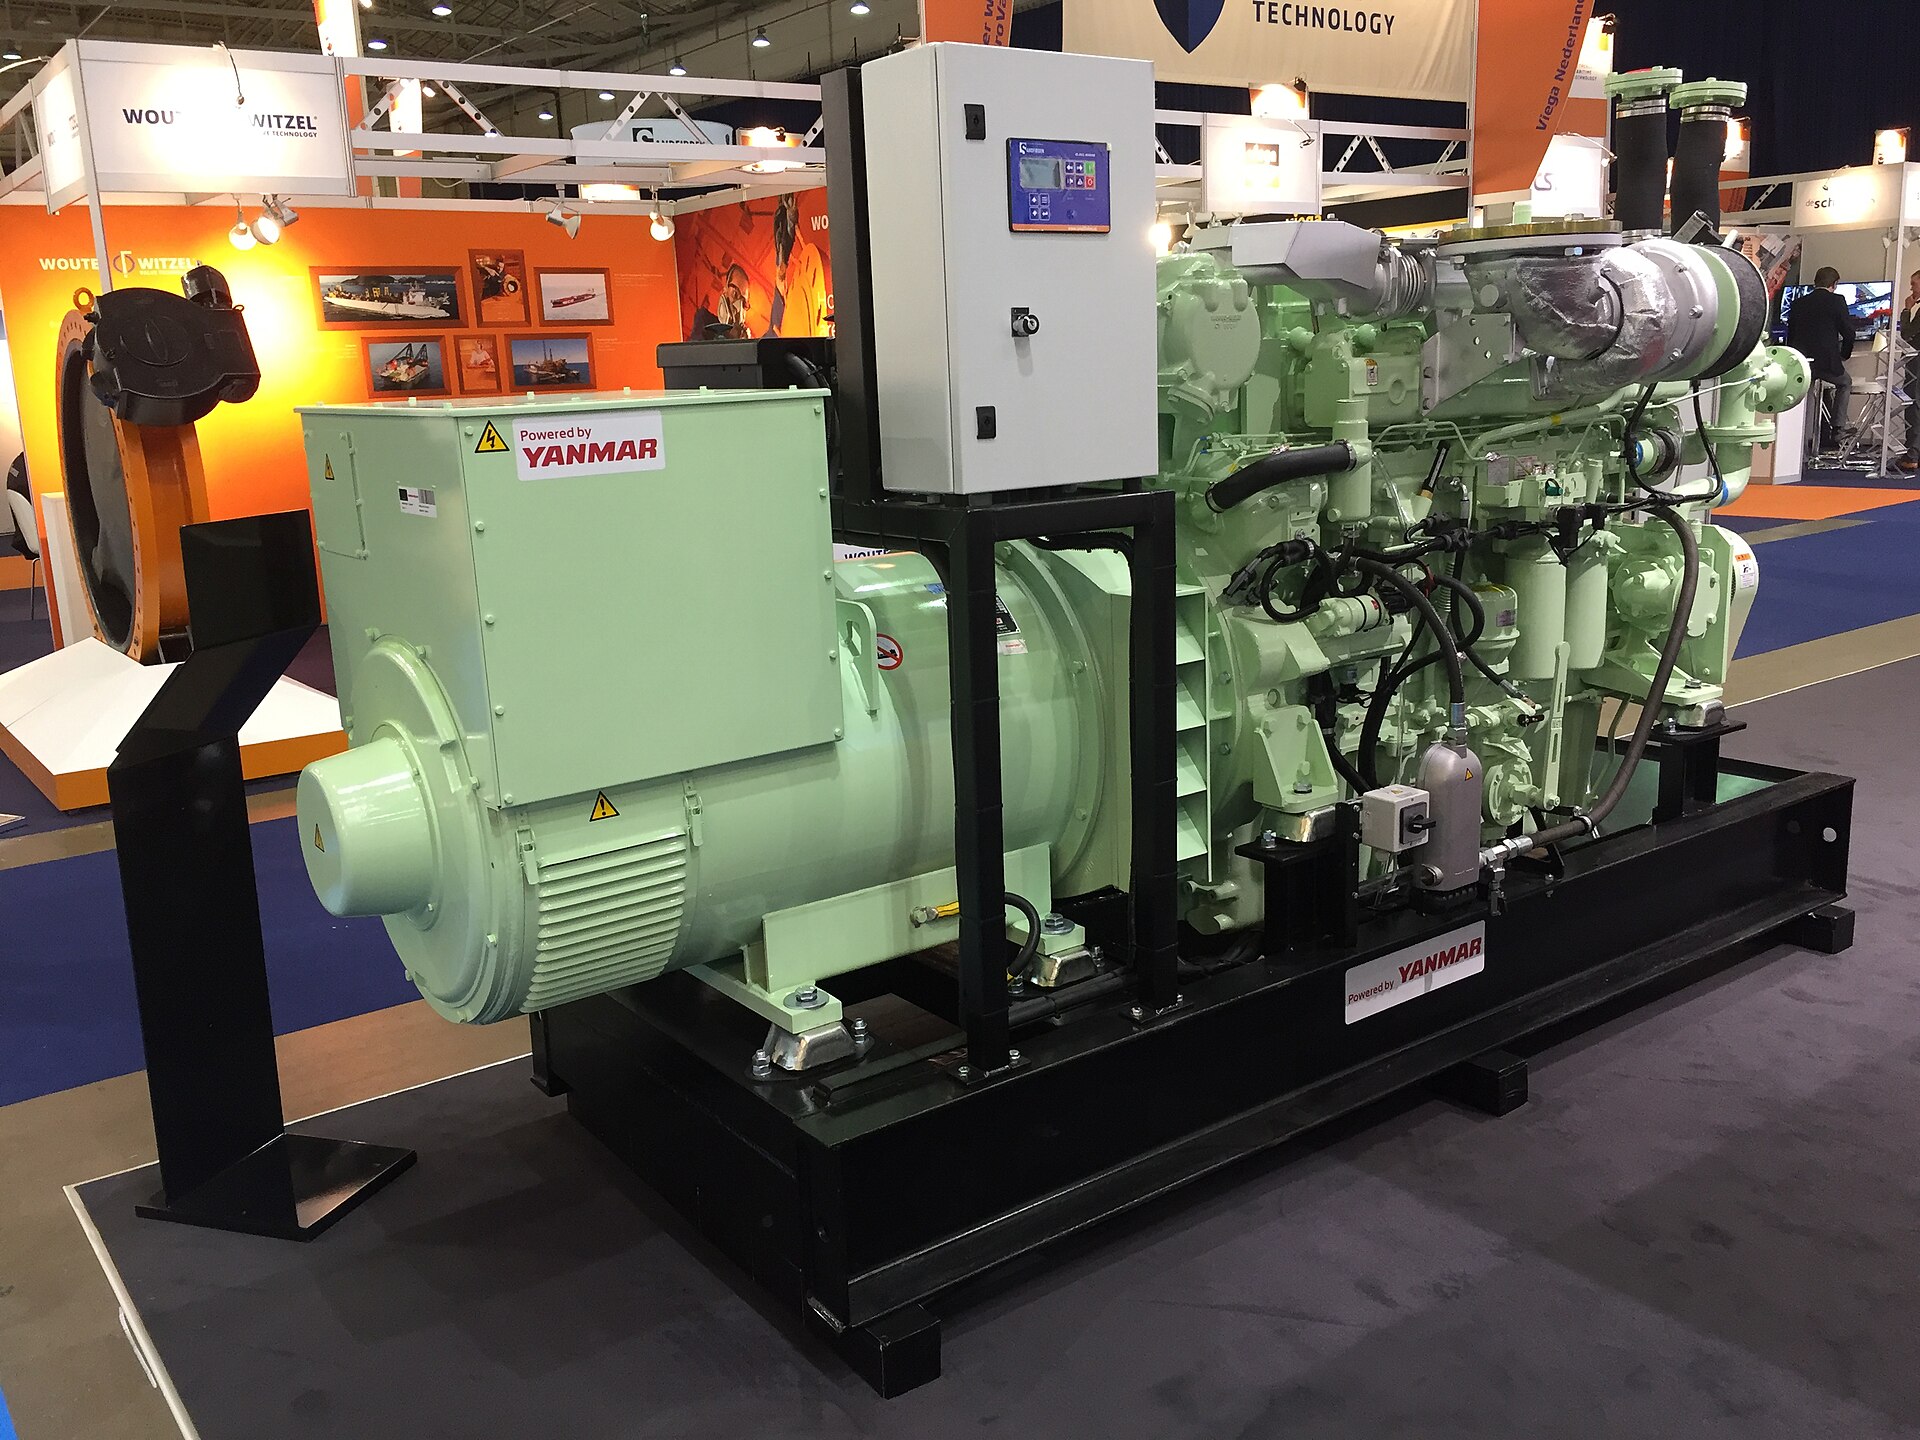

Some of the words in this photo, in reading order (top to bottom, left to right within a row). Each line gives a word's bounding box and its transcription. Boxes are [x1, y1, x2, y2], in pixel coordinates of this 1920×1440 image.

[1252, 1, 1395, 35] TECHNOLOGY
[1536, 86, 1560, 131] Viega
[1554, 0, 1585, 81] Nederlan
[122, 108, 182, 125] WOU
[39, 257, 100, 271] WOUTE
[137, 257, 193, 270] WITZEL
[519, 427, 575, 442] Powered
[576, 426, 592, 440] by
[522, 438, 658, 468] YANMAR
[1348, 981, 1383, 1005] Powered
[1384, 980, 1395, 992] by
[1398, 936, 1482, 984] YANMAR
